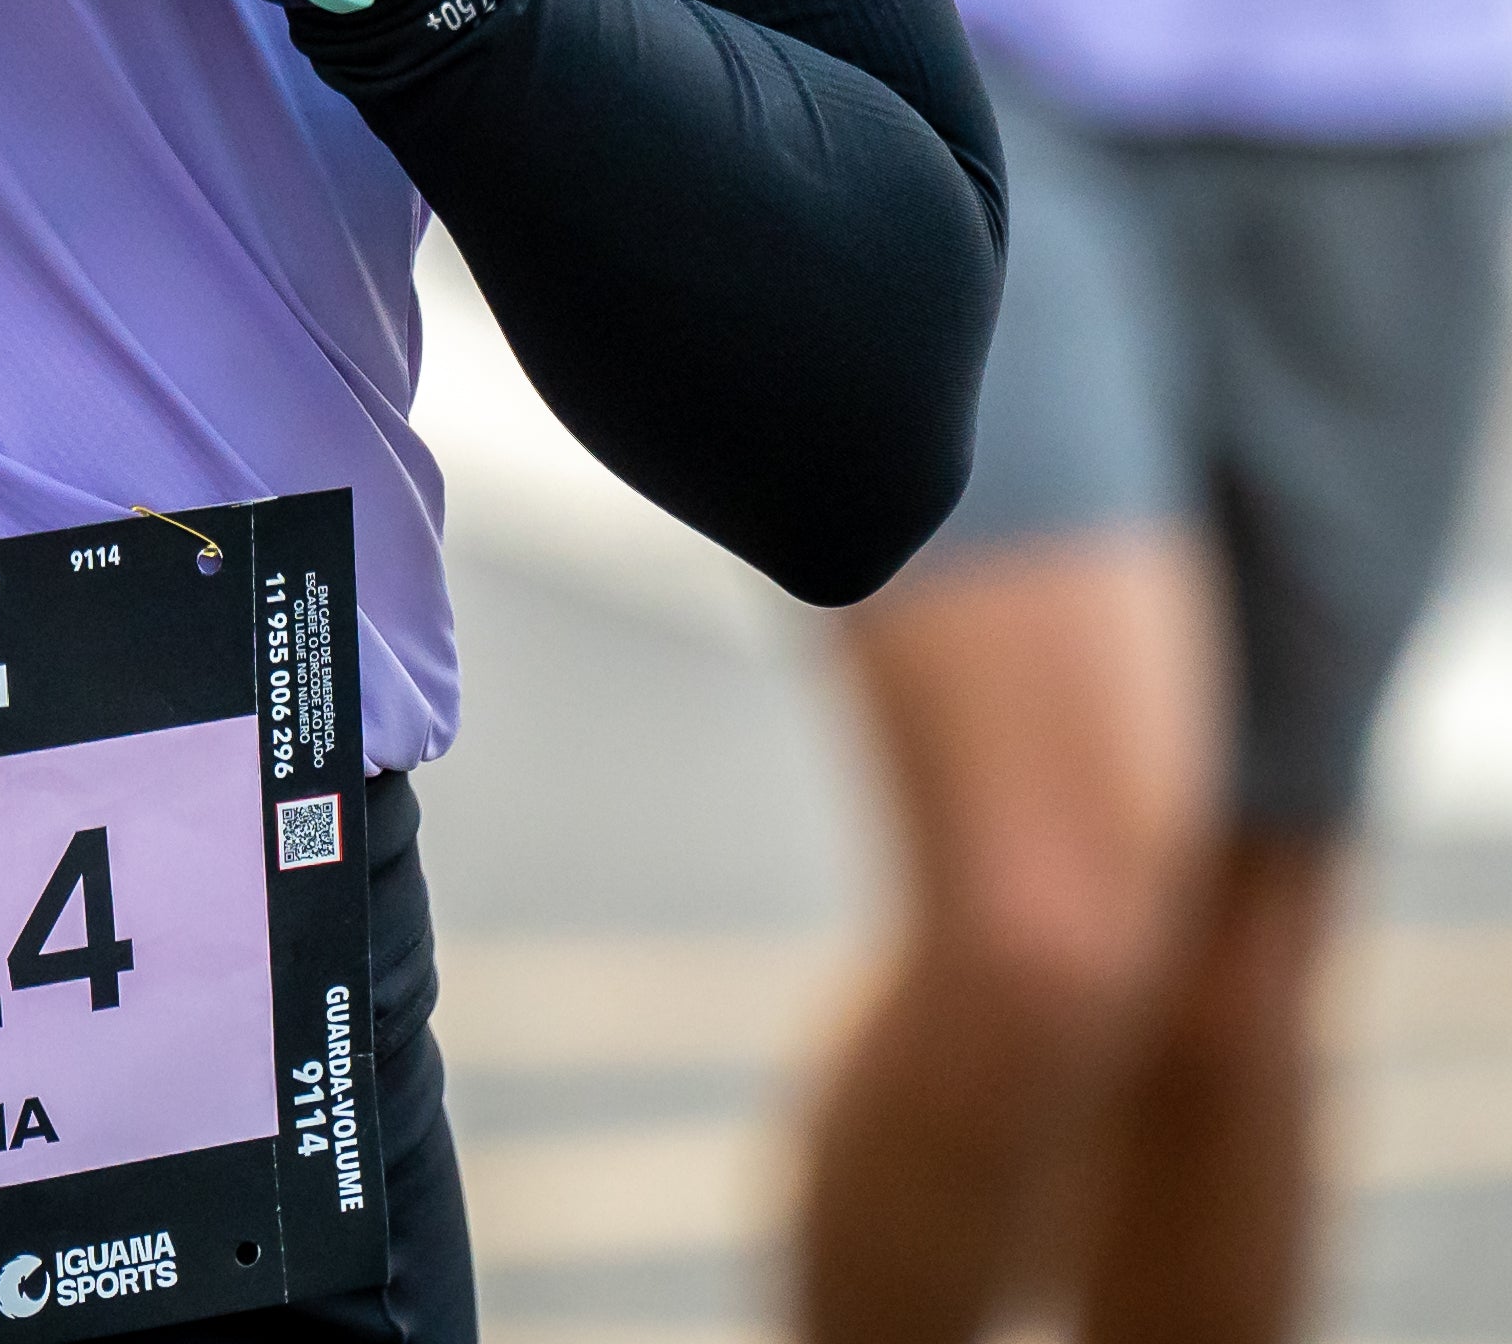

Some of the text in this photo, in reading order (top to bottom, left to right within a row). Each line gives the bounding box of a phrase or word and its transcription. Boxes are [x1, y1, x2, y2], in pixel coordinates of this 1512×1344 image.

[69, 543, 122, 572] 9114
[265, 572, 294, 779] 11 955 006 296
[294, 600, 310, 744] OU LIGUE NO NÚMERO
[305, 572, 324, 768] ESCANEIE O QRCODE AO LADO
[317, 585, 335, 752] EM CASO DE EMERGÊNCIA
[293, 1061, 328, 1156] 9114
[326, 986, 364, 1213] GUARDA-VOLUME
[55, 1231, 177, 1278] IGUANA
[56, 1261, 178, 1307] SPORTS
